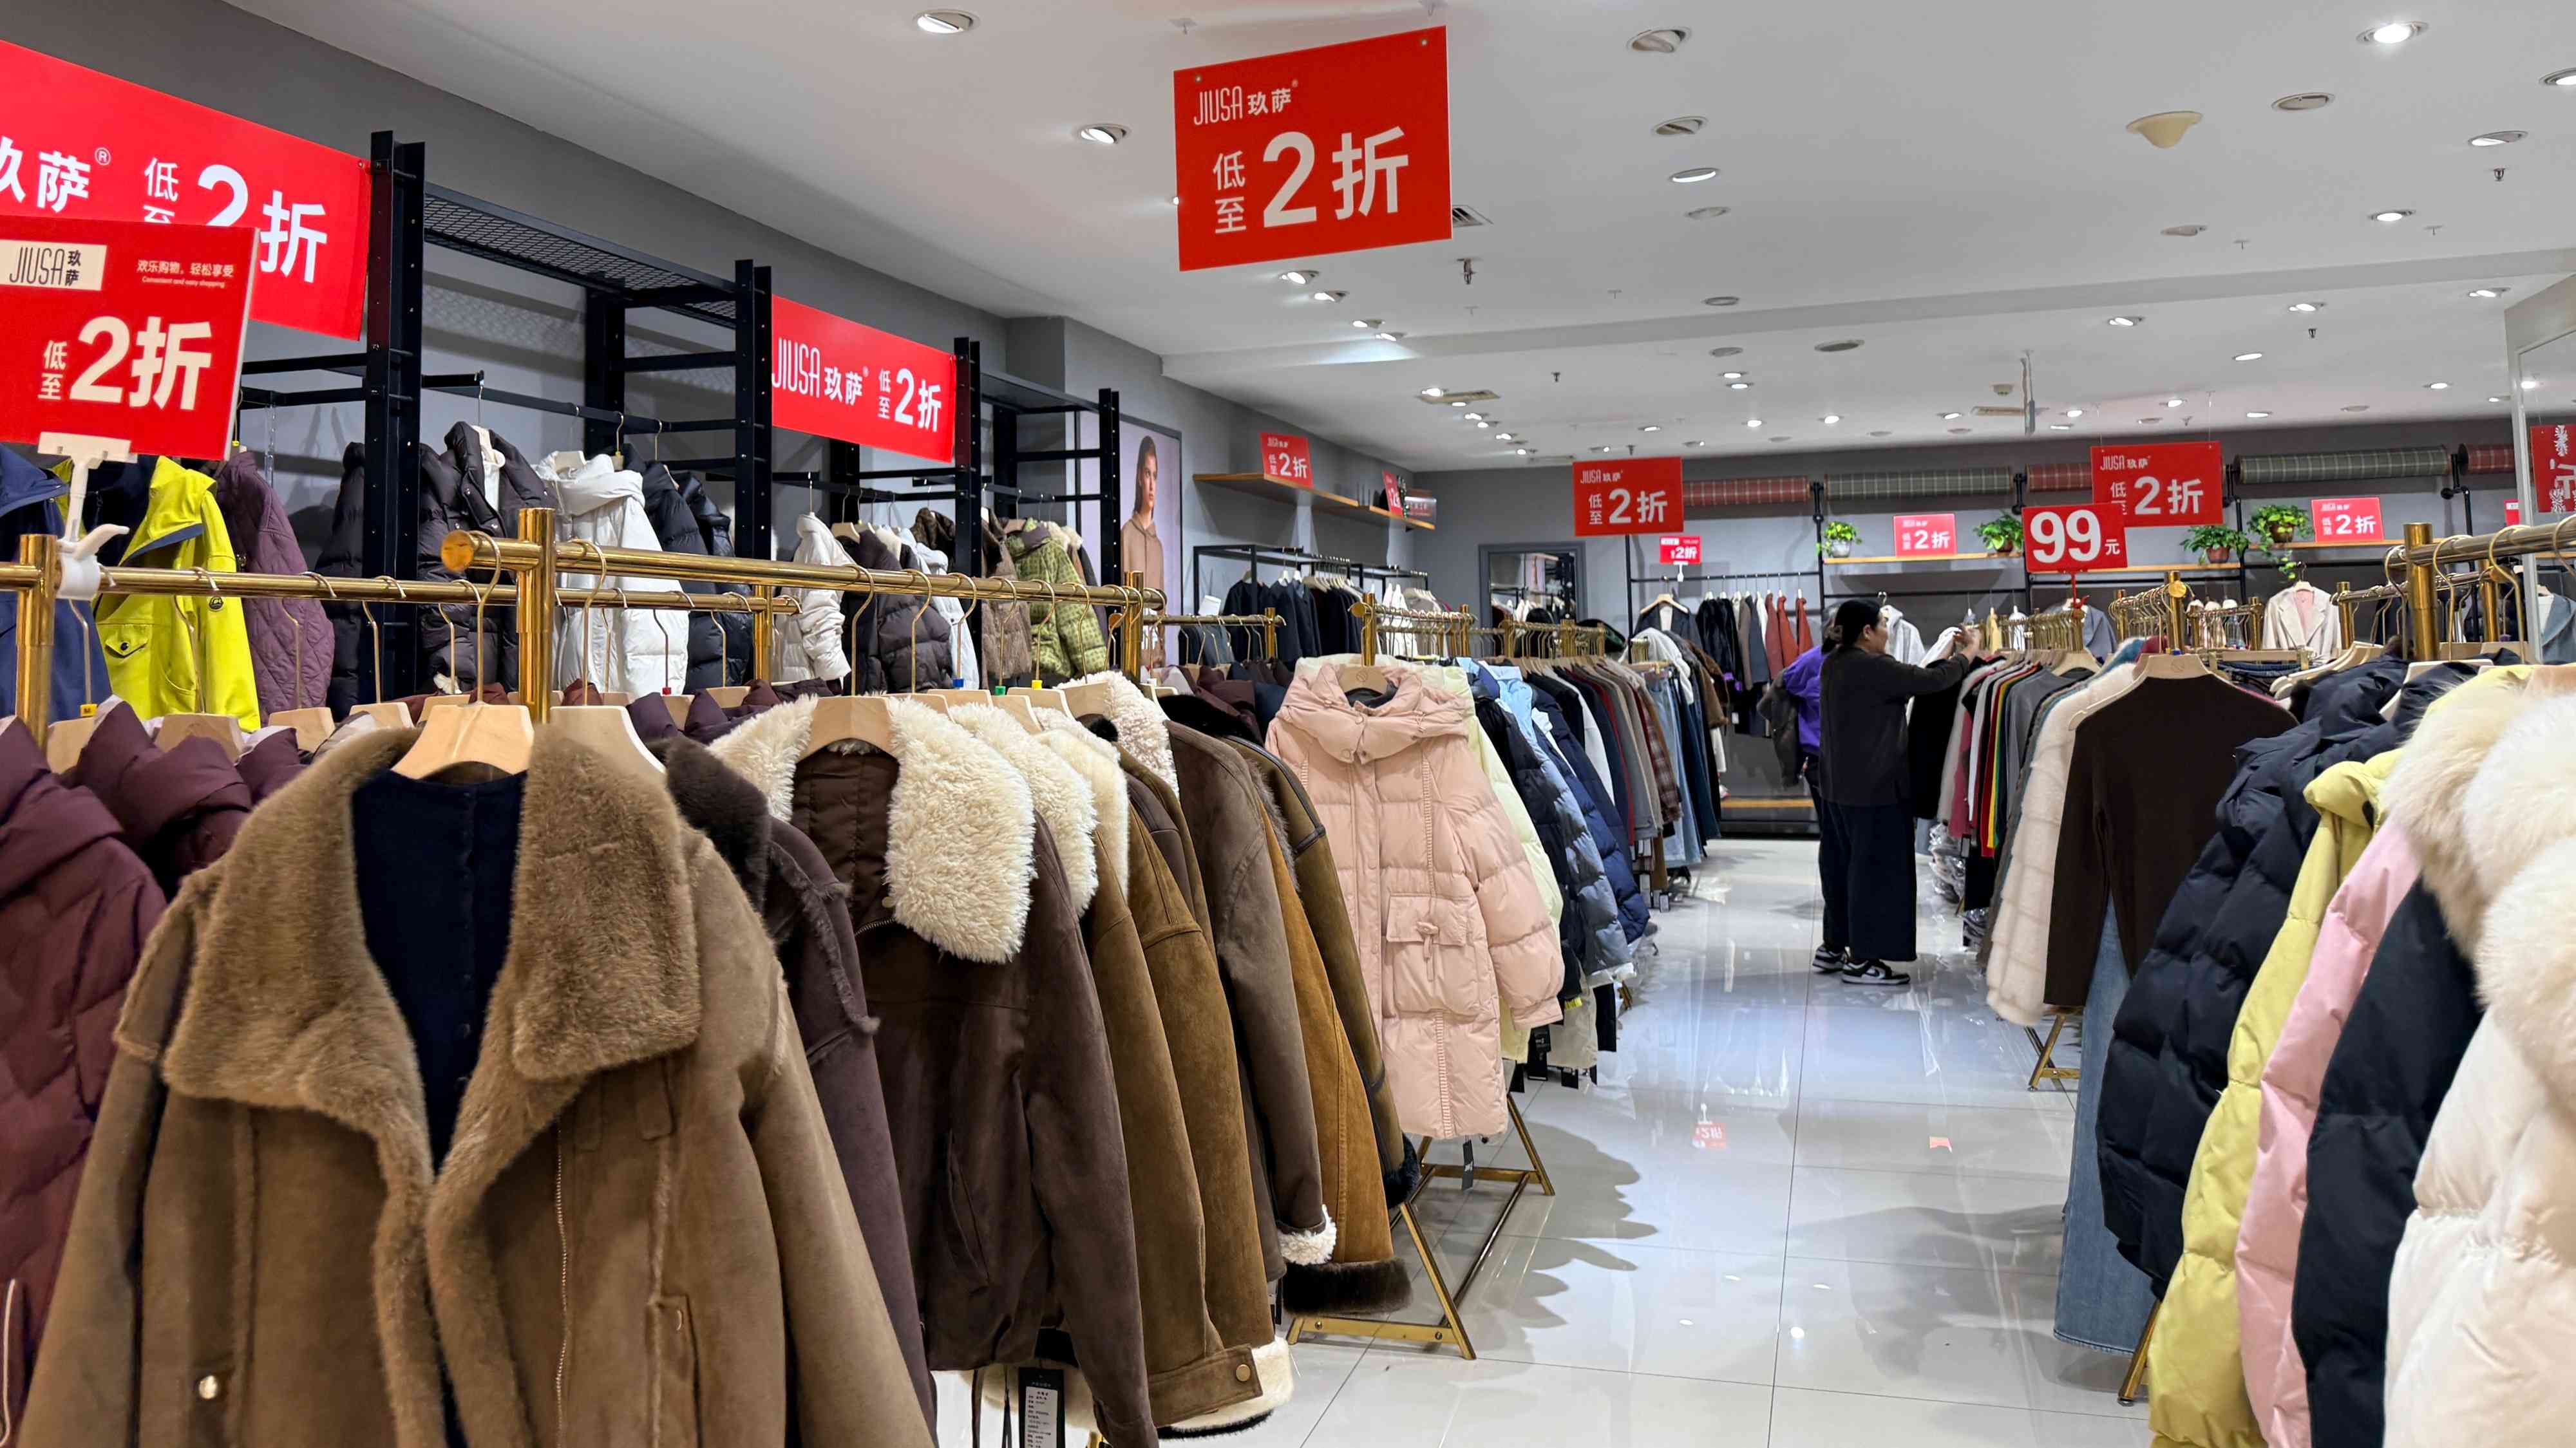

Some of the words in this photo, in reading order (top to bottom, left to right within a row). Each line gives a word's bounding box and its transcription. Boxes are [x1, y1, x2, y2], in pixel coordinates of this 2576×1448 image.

[1193, 86, 1244, 126] JIUSA
[1247, 88, 1291, 116] 玖萨
[1213, 150, 1247, 234] 低至
[1262, 126, 1409, 228] 2折
[10, 246, 66, 286] JIUSA
[65, 250, 82, 287] 玖萨
[37, 340, 68, 400] 低至
[69, 315, 213, 411] 2折
[772, 337, 820, 399] JIUSA
[824, 366, 863, 406] 玖萨
[878, 368, 891, 420] 低至
[895, 368, 942, 433] 2折
[1279, 453, 1308, 479] 2折
[1580, 469, 1602, 485] JIUSA
[2100, 455, 2125, 471] JIUSA
[1588, 493, 1604, 525] 低至
[1609, 488, 1668, 524] 2折
[2134, 476, 2204, 515] 2折
[1915, 529, 1951, 550] 2折
[2335, 514, 2377, 535] 2折
